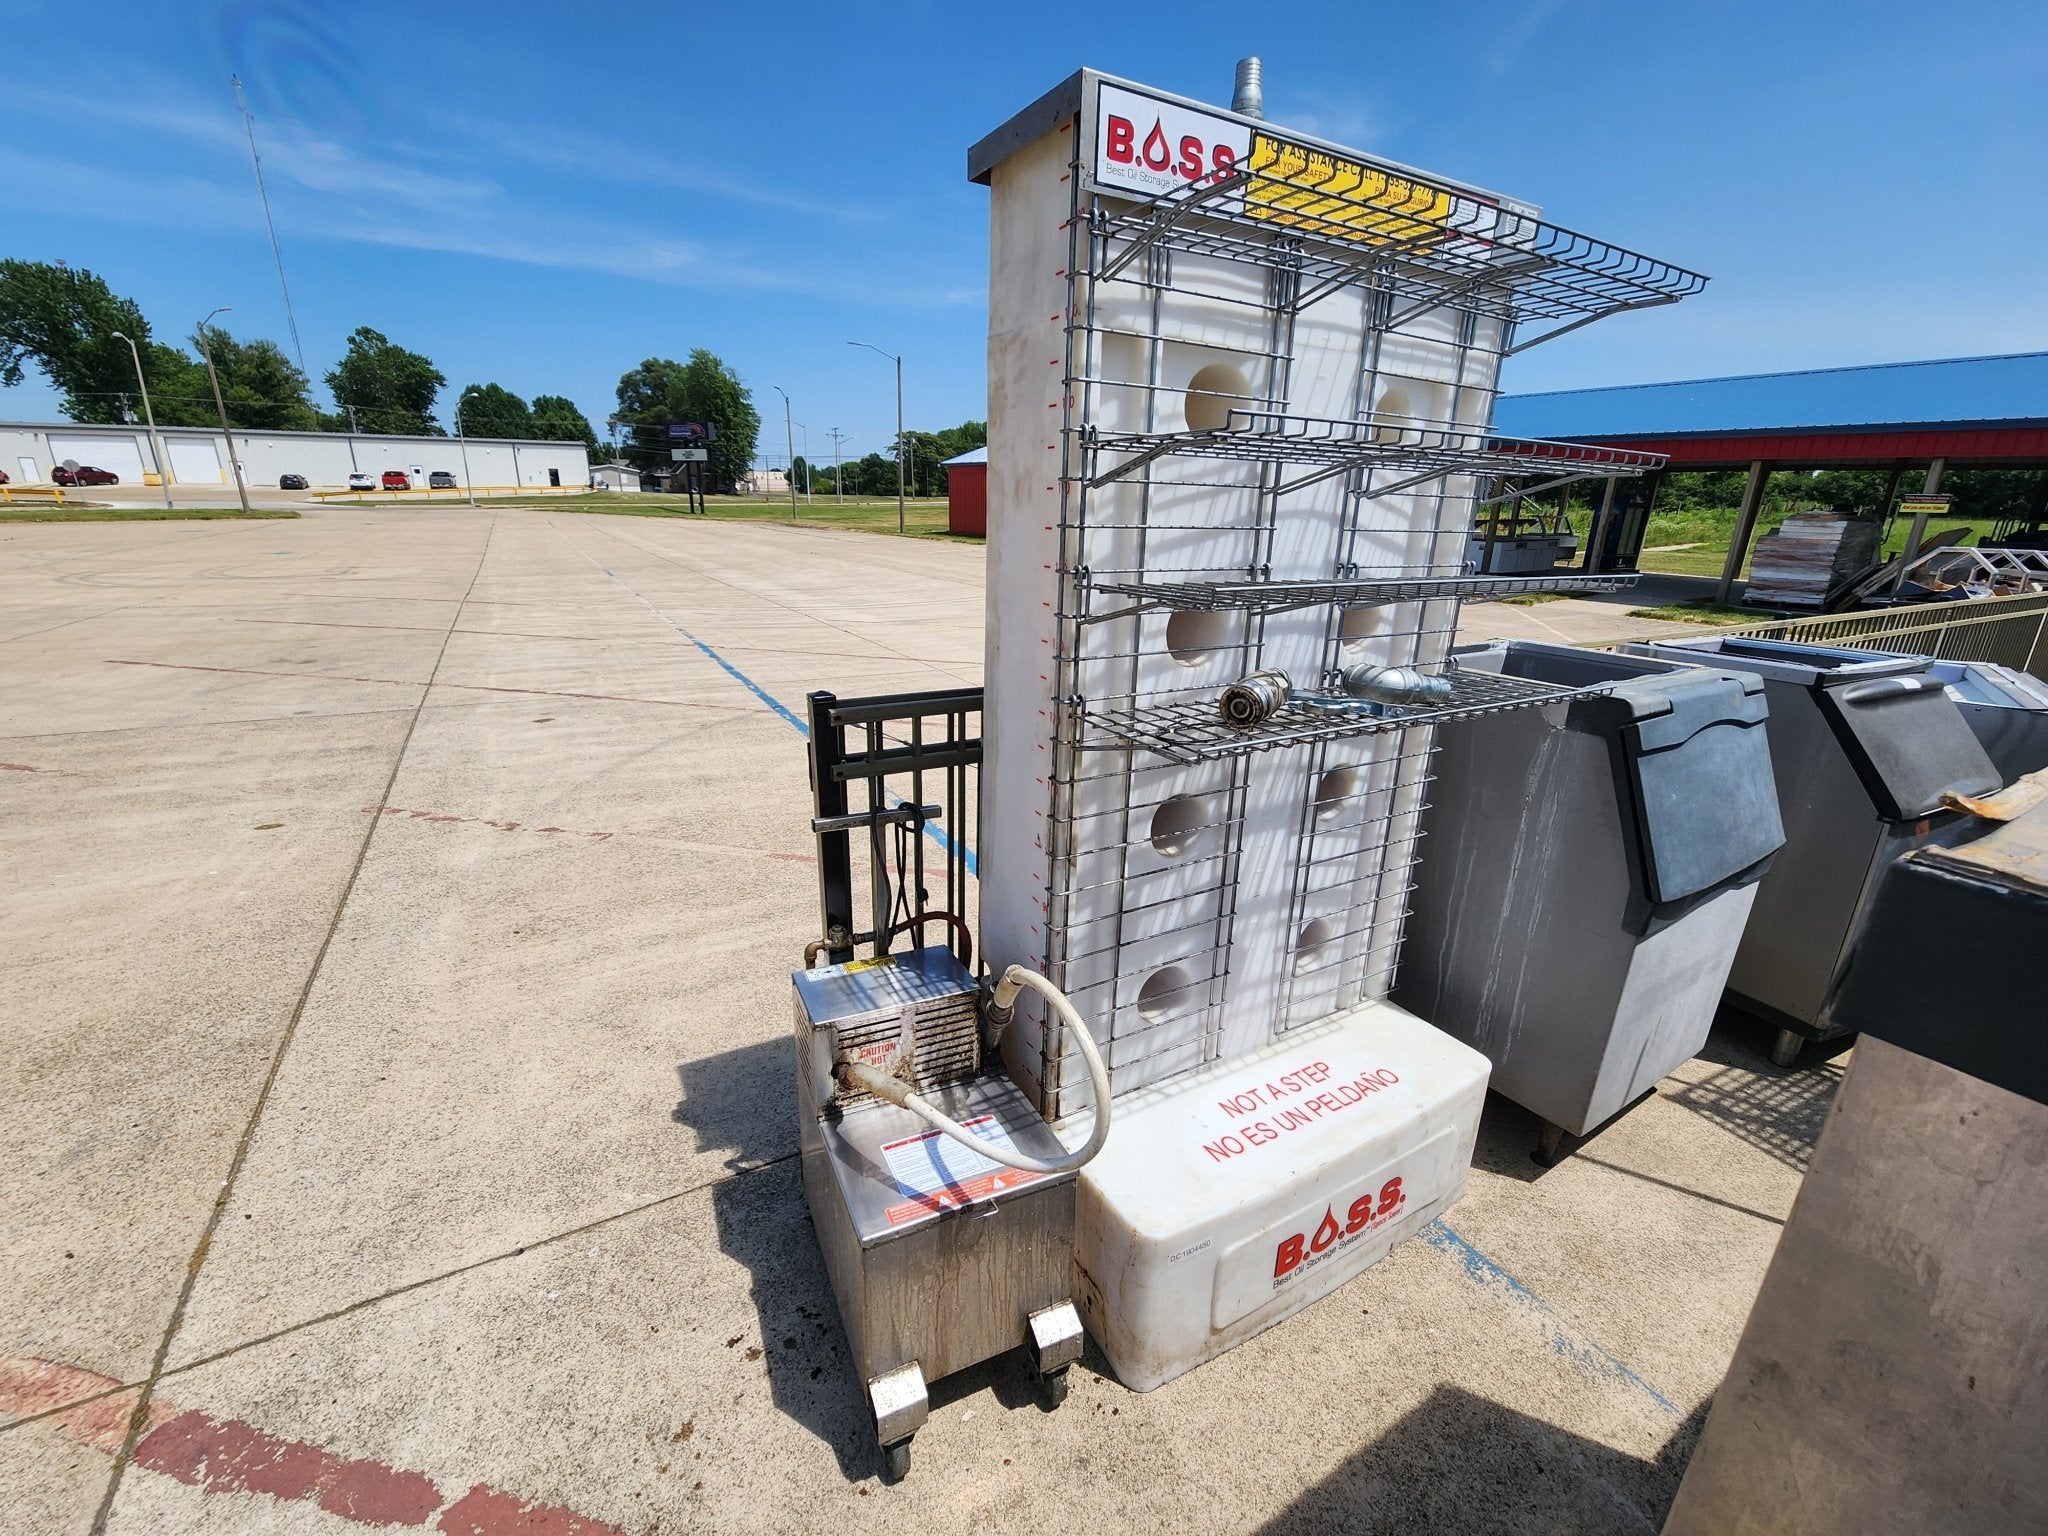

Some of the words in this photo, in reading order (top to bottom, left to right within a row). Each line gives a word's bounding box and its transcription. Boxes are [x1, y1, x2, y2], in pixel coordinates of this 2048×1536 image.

[1106, 163, 1126, 177] Best
[1127, 169, 1137, 180] Oil
[1139, 172, 1171, 189] Storage
[1265, 139, 1286, 156] FOR
[1289, 146, 1348, 174] ASSSTANCE
[1350, 164, 1373, 181] CLL
[860, 1042, 897, 1059] CAUTION
[871, 1055, 887, 1066] HOT
[1218, 1088, 1268, 1119] NOT
[1266, 1083, 1289, 1101] A
[1280, 1061, 1331, 1093] STEP
[1202, 1136, 1245, 1163] NO
[1240, 1122, 1279, 1146] ES
[1271, 1106, 1313, 1131] UN
[1304, 1068, 1399, 1118] PELDAÑO
[1273, 1273, 1293, 1290] Best
[1294, 1265, 1305, 1277] Oil
[1306, 1246, 1337, 1270] Storage
